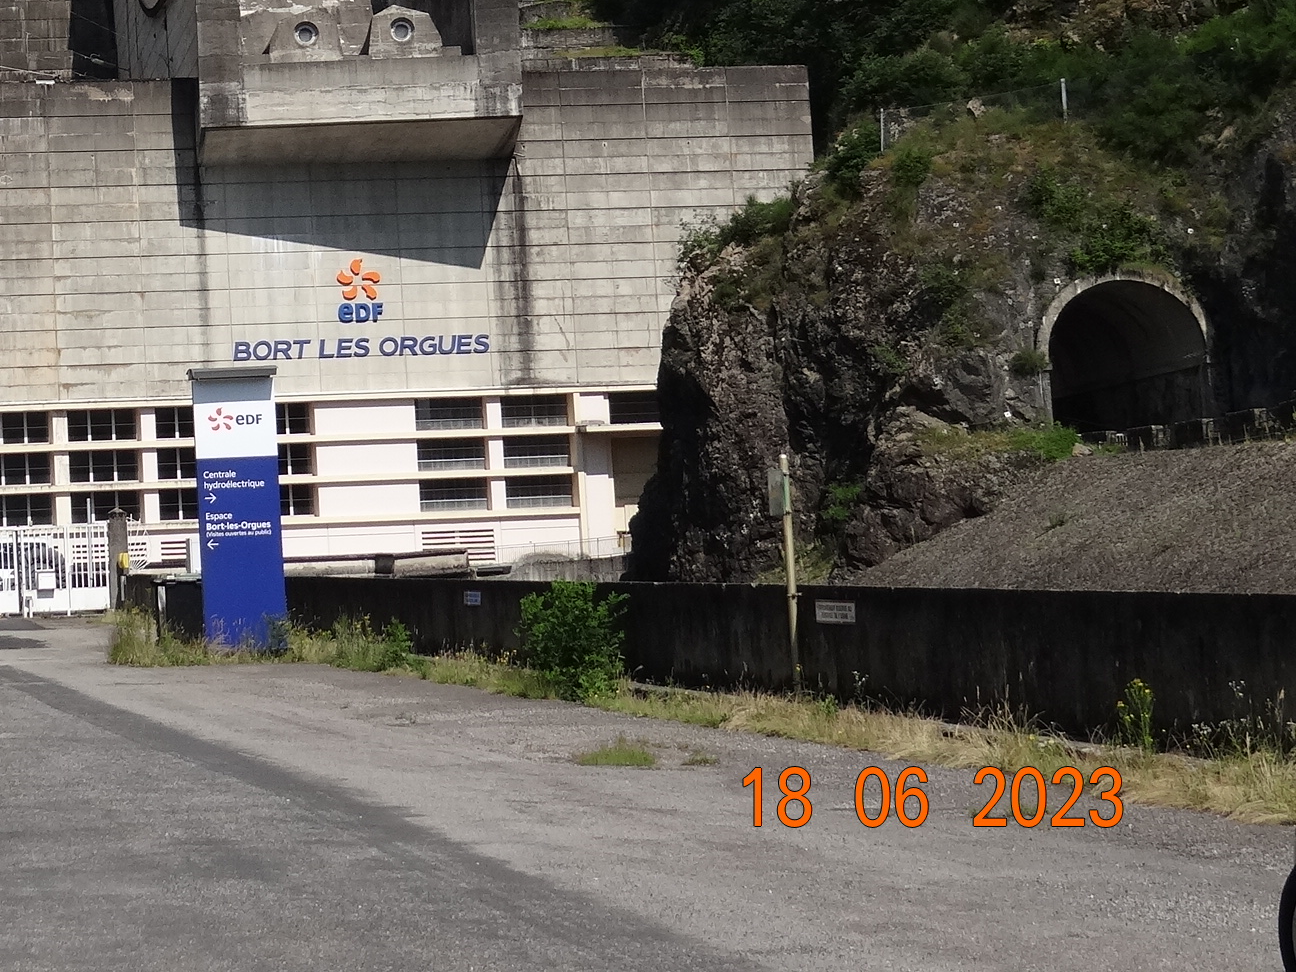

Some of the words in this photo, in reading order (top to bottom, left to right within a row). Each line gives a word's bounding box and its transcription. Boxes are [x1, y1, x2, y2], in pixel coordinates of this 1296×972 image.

[233, 339, 311, 362] BORT
[318, 337, 370, 359] LES
[378, 333, 490, 357] ORGUES
[203, 470, 237, 479] Centrale
[204, 479, 265, 491] hydroélectrique
[205, 512, 233, 521] Espace
[206, 521, 272, 531] Bort-les-Orgues
